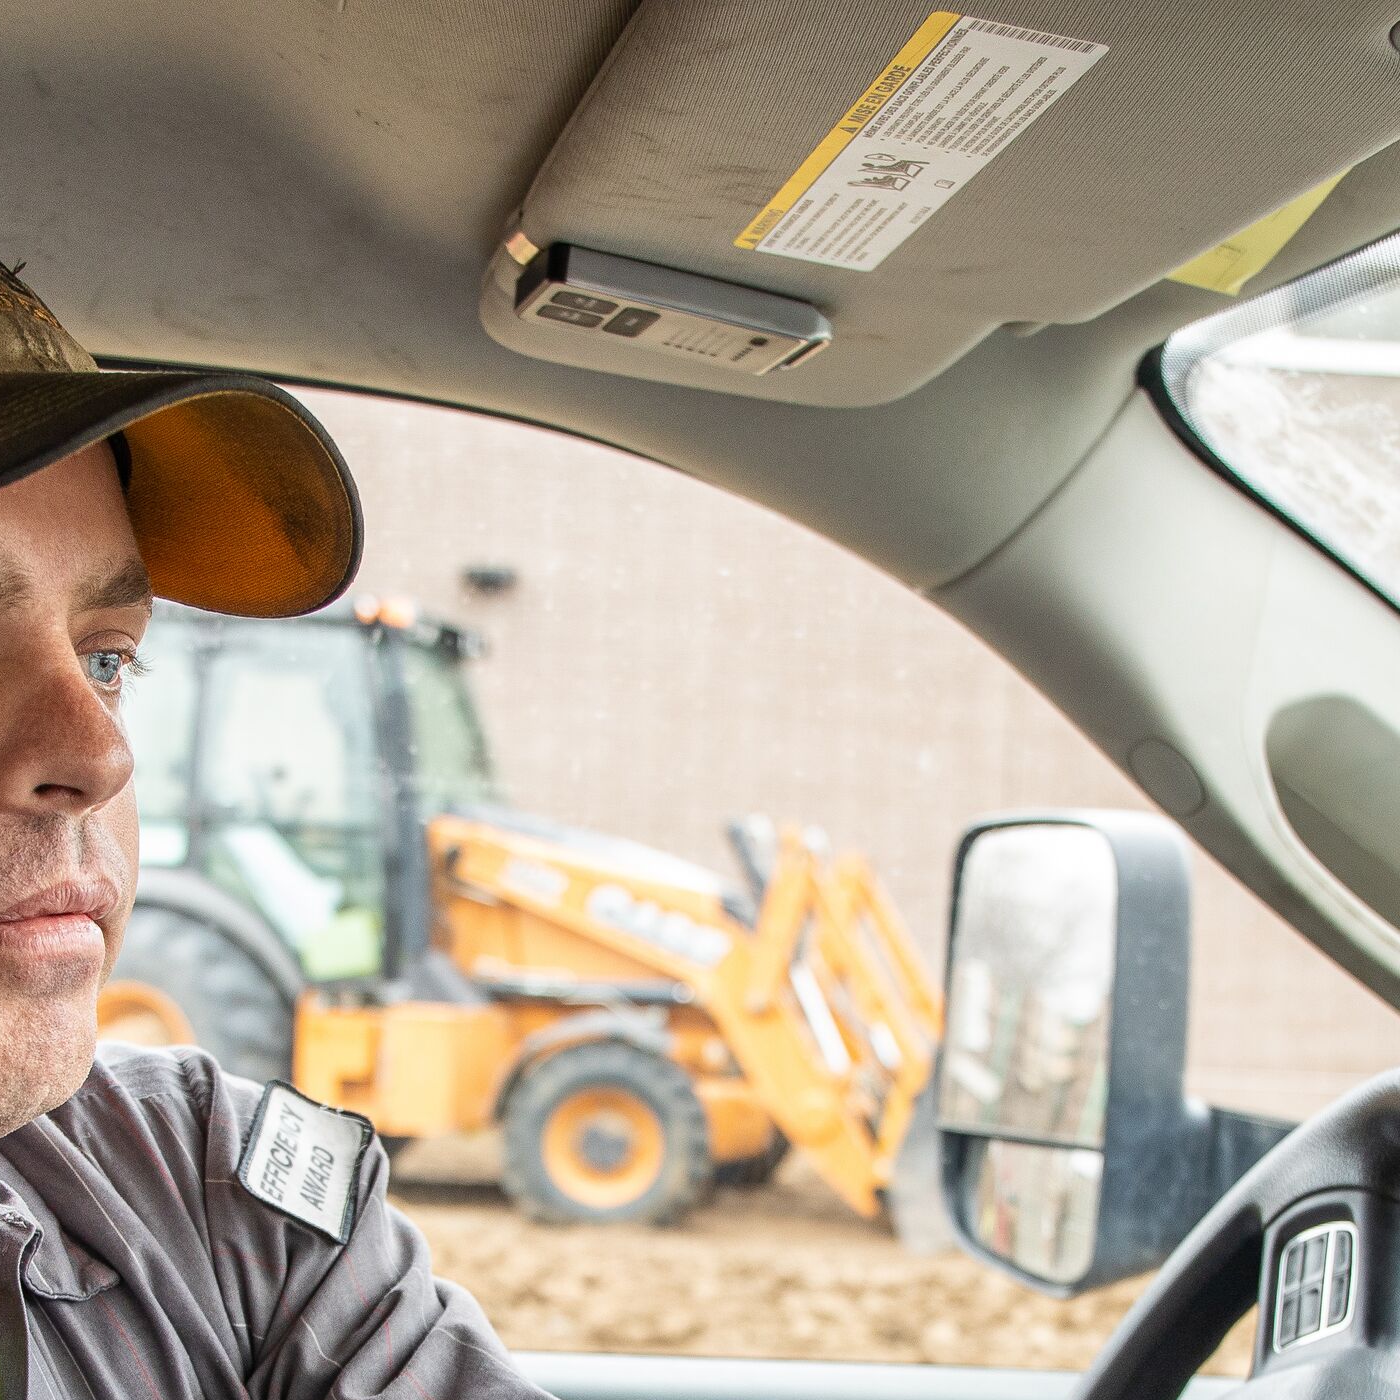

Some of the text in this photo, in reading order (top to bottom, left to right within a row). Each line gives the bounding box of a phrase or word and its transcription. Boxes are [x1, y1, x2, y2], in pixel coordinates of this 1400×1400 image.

[847, 65, 911, 123] MISE EN GARDE
[300, 1145, 335, 1212] AWARD
